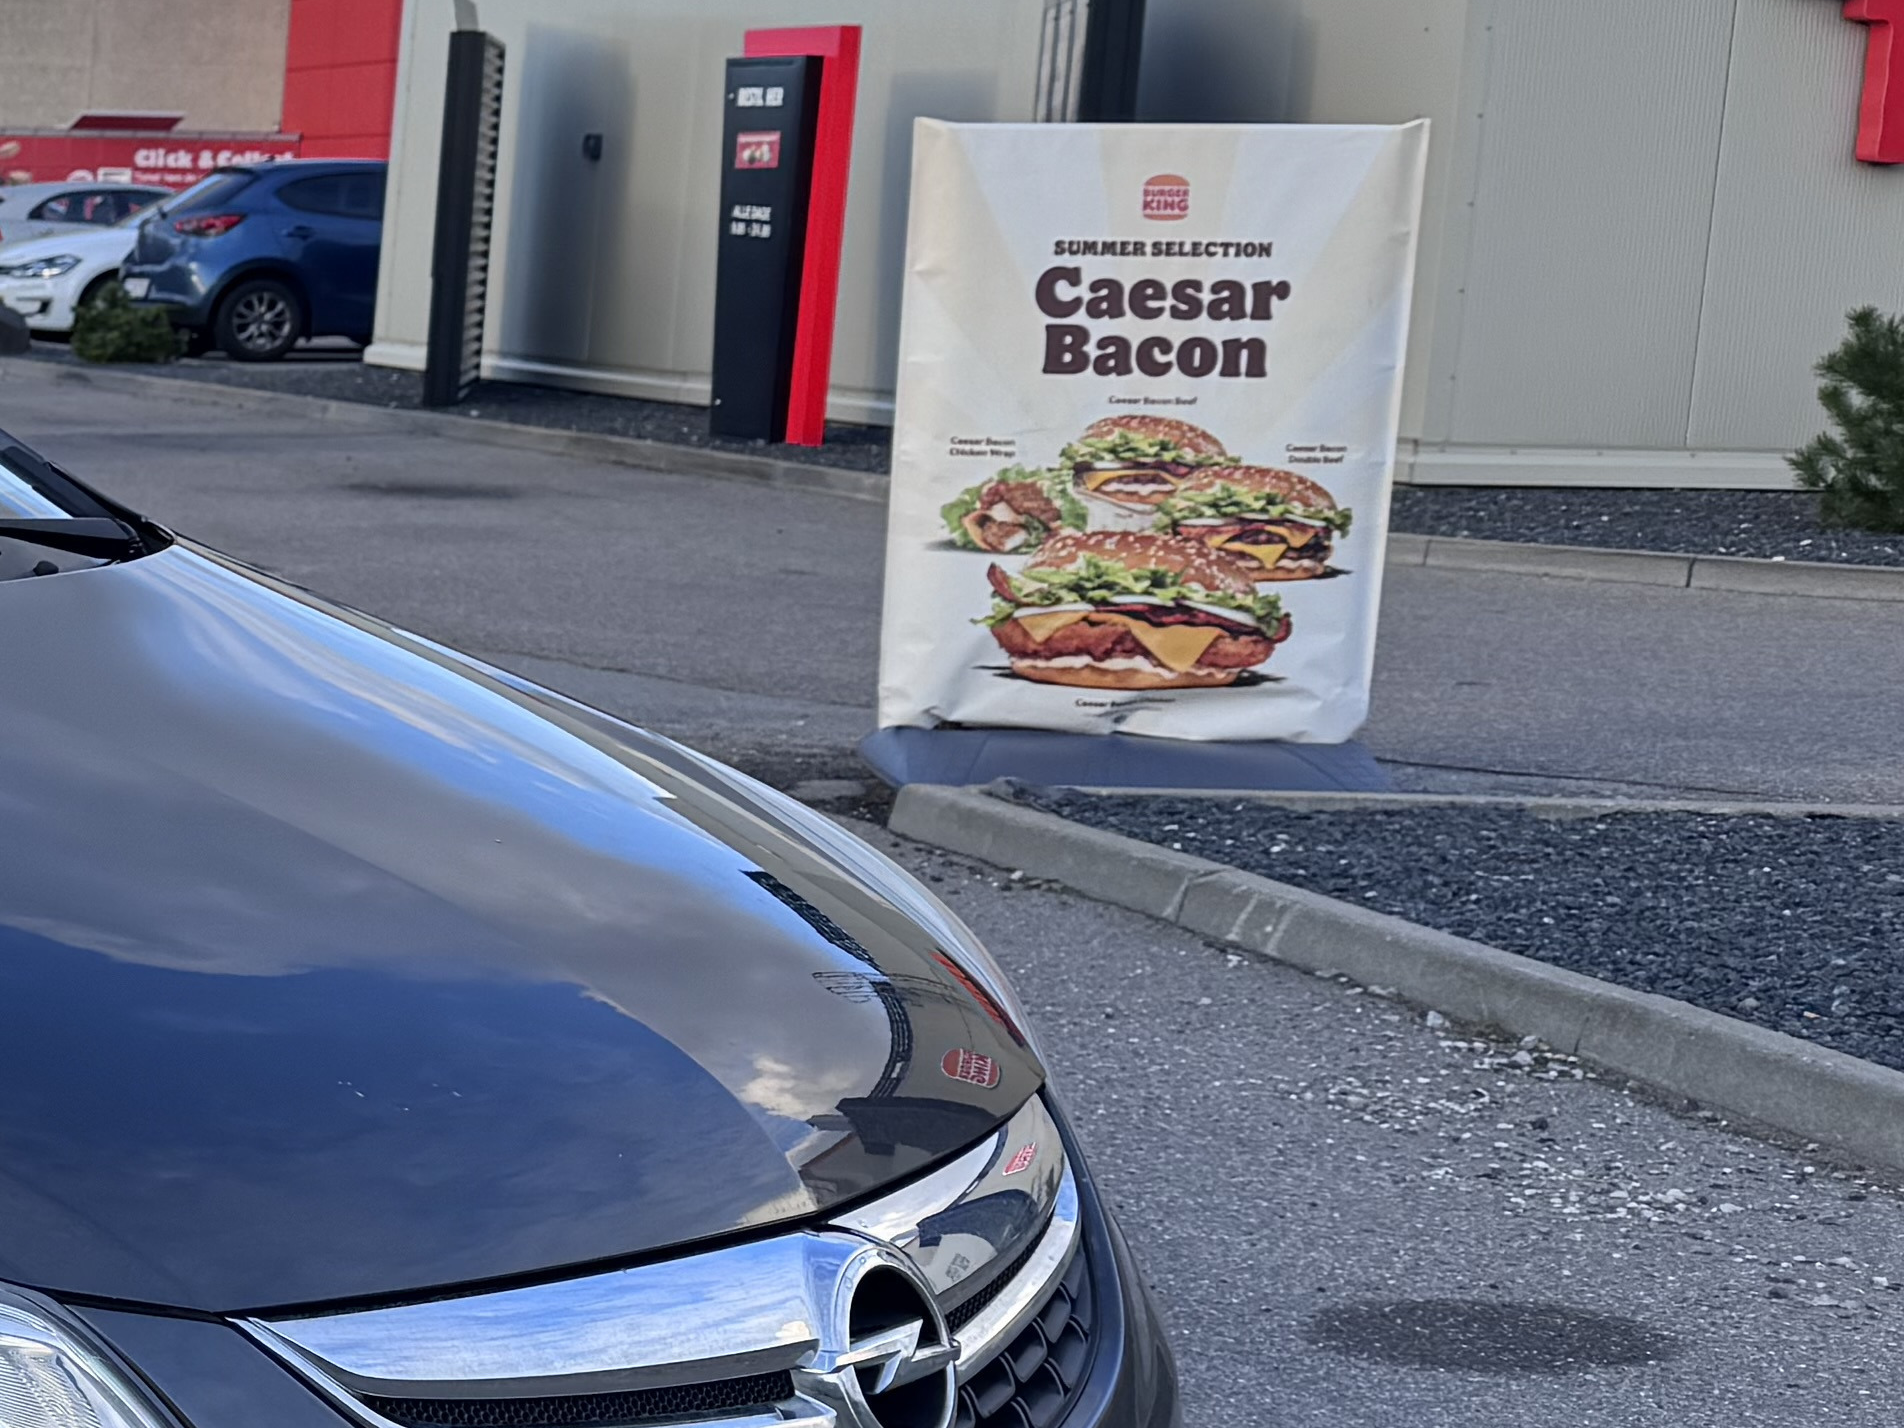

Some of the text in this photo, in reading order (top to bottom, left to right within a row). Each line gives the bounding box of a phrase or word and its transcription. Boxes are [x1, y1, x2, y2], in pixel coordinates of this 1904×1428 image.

[134, 148, 193, 169] Click
[197, 149, 214, 168] &
[1143, 188, 1190, 198] BURGER
[1143, 199, 1190, 212] KING
[1054, 240, 1273, 258] SUMMER SELECTION
[1035, 265, 1292, 321] Caesar
[1042, 324, 1268, 378] Bacon
[950, 436, 985, 446] Caesar
